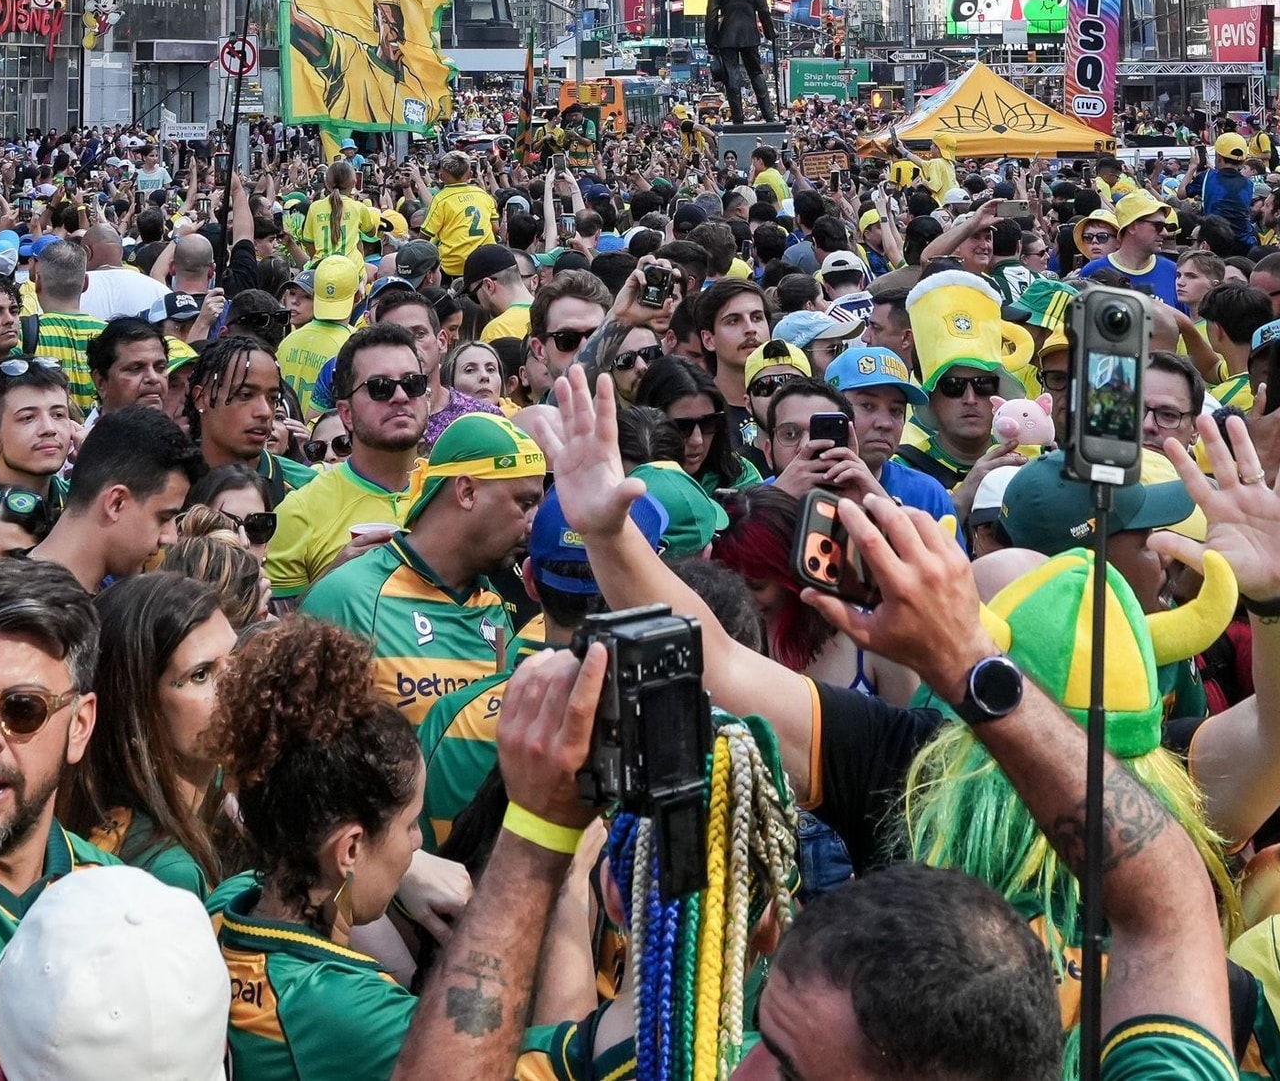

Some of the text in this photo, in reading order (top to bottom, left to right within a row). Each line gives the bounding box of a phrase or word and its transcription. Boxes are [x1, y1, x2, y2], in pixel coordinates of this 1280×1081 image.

[1212, 19, 1257, 49] Levi's
[804, 72, 823, 81] Ship
[1076, 101, 1099, 111] LIVE
[465, 205, 485, 237] 2
